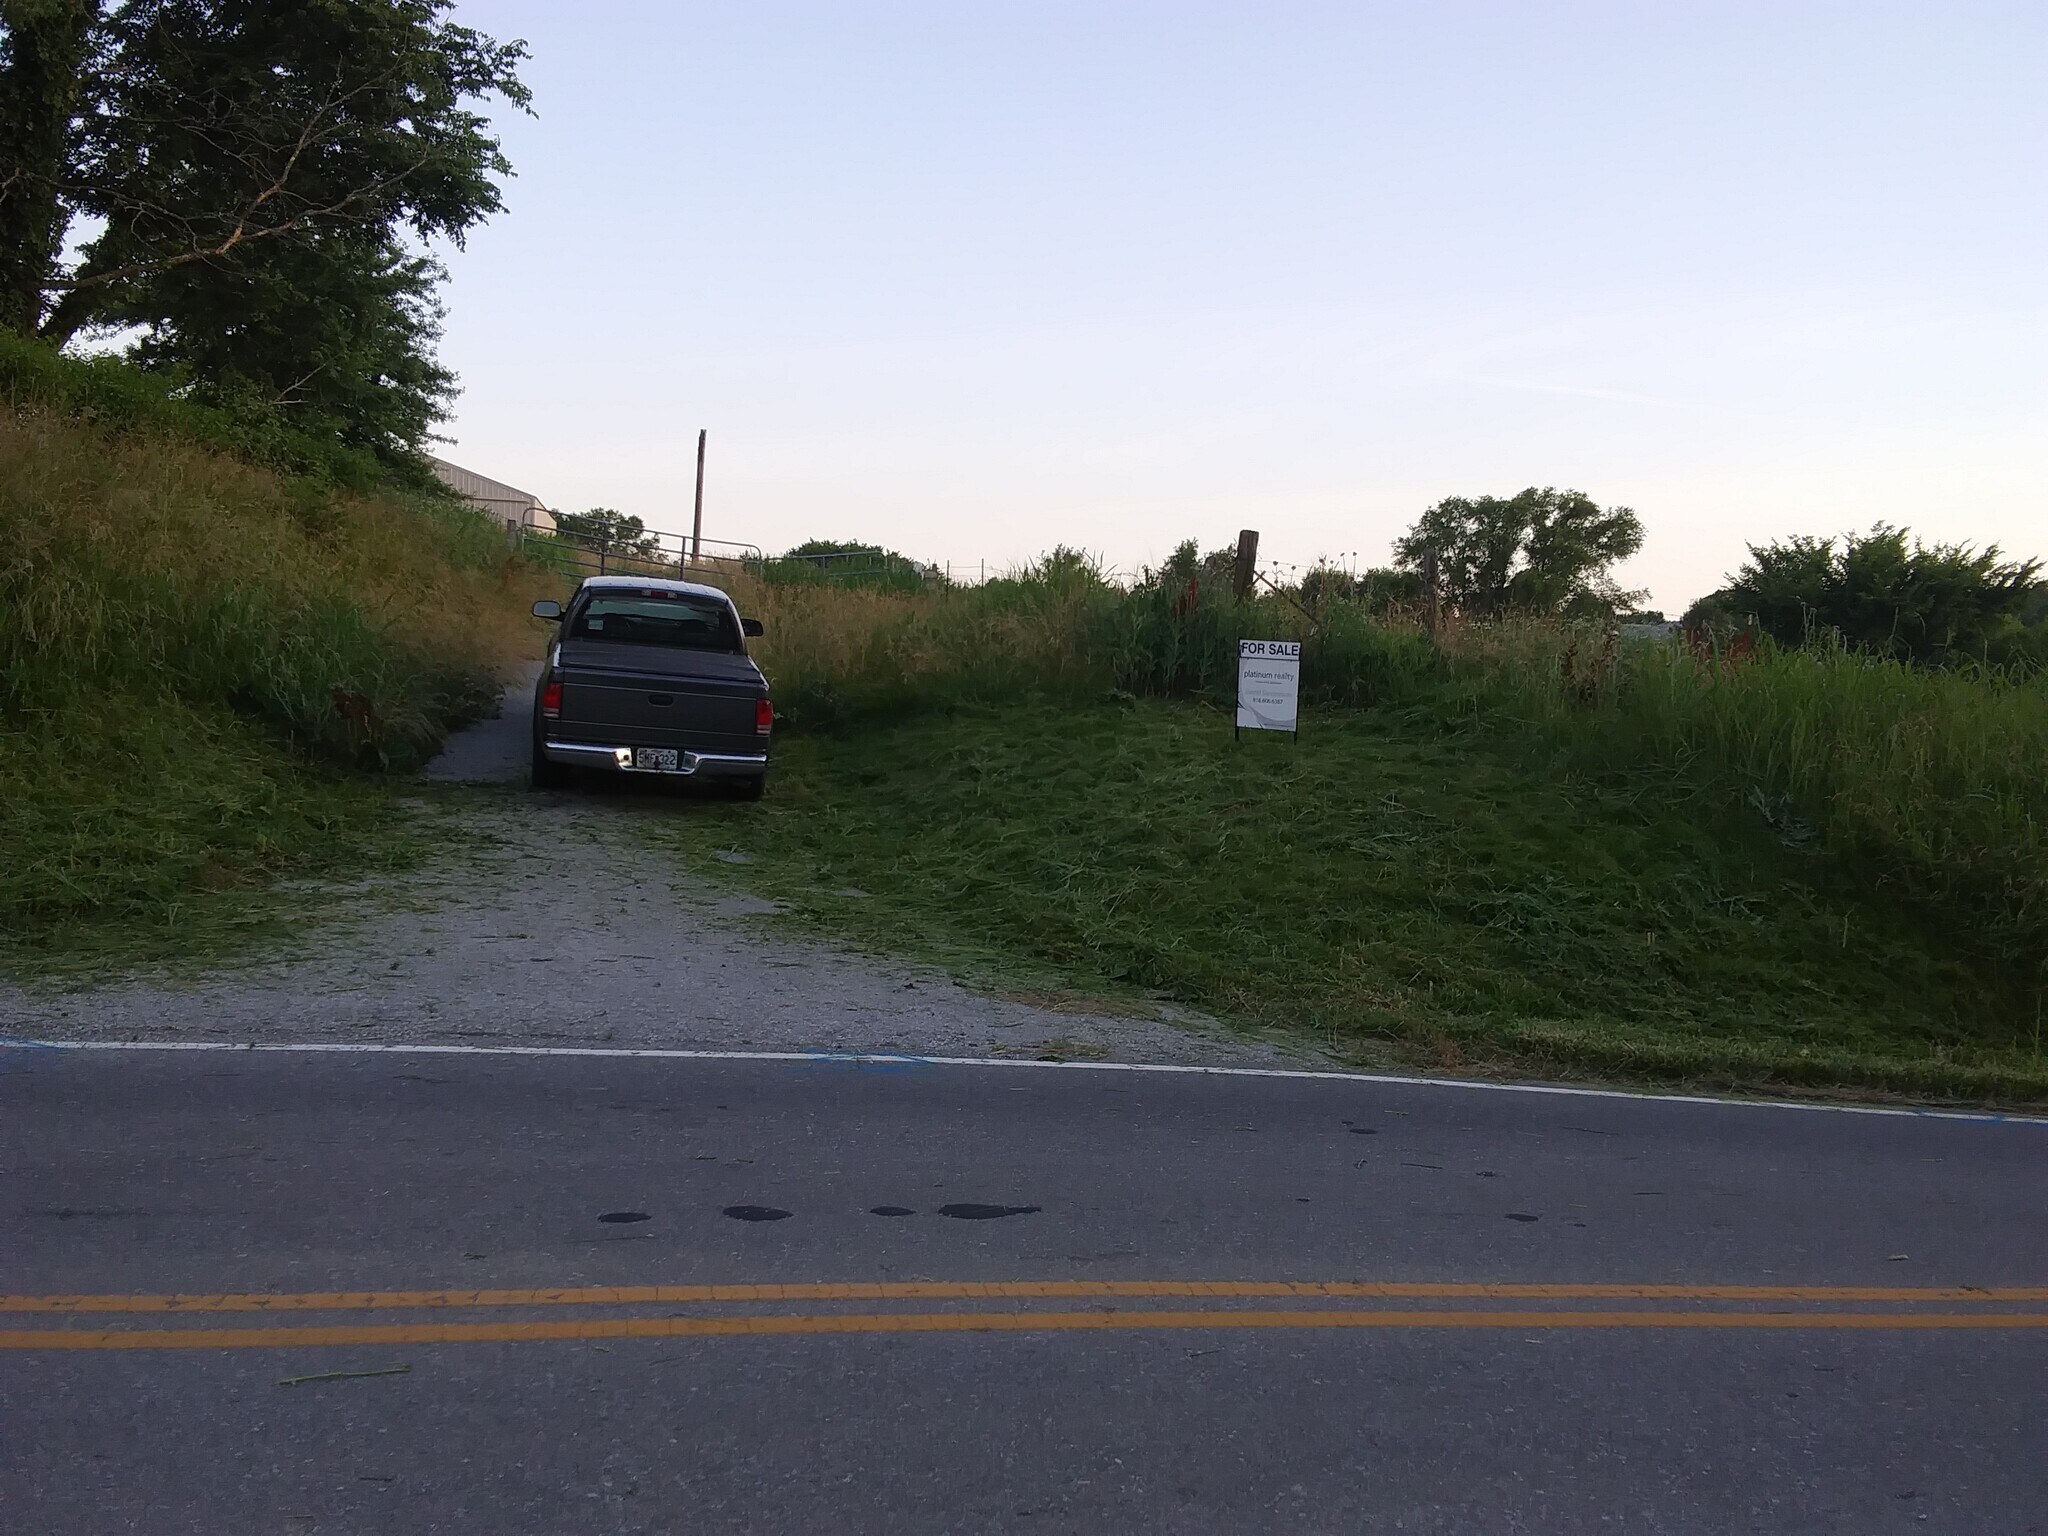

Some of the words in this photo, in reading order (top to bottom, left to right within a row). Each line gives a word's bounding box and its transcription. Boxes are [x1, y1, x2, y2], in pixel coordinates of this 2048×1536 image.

[1241, 642, 1265, 655] FOR
[1269, 643, 1299, 656] SALE
[1243, 670, 1273, 679] platinum
[1274, 672, 1295, 682] realty
